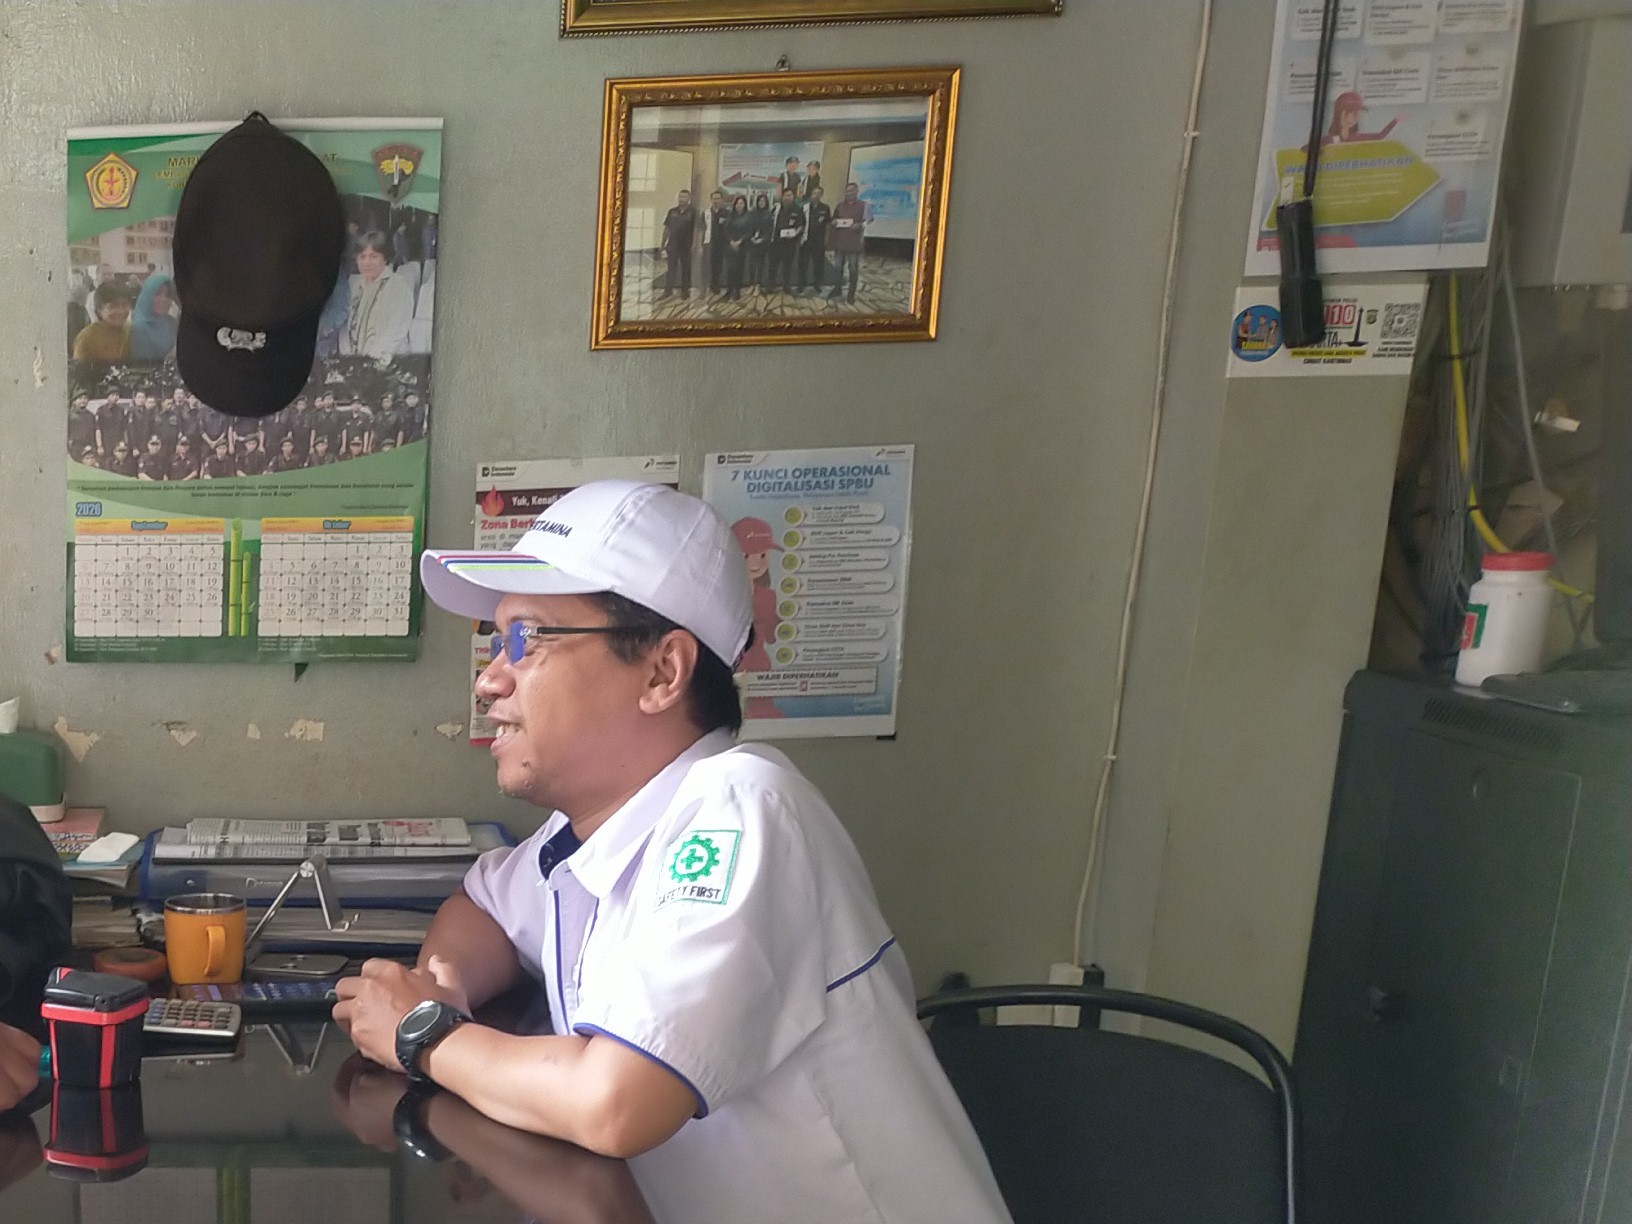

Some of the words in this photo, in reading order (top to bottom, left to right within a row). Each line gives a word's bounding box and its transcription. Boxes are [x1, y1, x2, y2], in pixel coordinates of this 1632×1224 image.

[731, 470, 741, 482] 7
[743, 467, 789, 482] KUNCI
[791, 464, 891, 480] OPERASIONAL
[746, 479, 836, 494] DIGITALISASI
[838, 477, 875, 490] SPBU
[512, 496, 530, 507] Yuk,
[480, 519, 508, 530] Zona
[125, 547, 130, 556] 1
[189, 546, 195, 555] 4
[210, 546, 216, 555] 5
[355, 545, 360, 554] 1
[104, 562, 110, 571] 7
[125, 562, 131, 571] 8
[145, 562, 152, 571] 9
[165, 562, 176, 571] 10
[186, 562, 196, 571] 11
[207, 562, 218, 570] 12
[290, 561, 296, 569] 5
[311, 561, 317, 569] 6
[333, 561, 338, 569] 7
[354, 561, 360, 569] 8
[376, 561, 382, 569] 9
[395, 560, 406, 569] 10
[101, 578, 111, 586] 14
[122, 578, 133, 586] 15
[164, 578, 175, 586] 17
[186, 577, 196, 586] 18
[207, 577, 218, 586] 19
[287, 576, 297, 585] 12
[308, 576, 318, 585] 13
[329, 576, 340, 585] 14
[351, 576, 361, 585] 15
[394, 576, 405, 584] 17
[101, 593, 111, 602] 21
[122, 593, 133, 601] 22
[164, 593, 175, 601] 24
[186, 593, 196, 601] 25
[206, 593, 218, 601] 26
[286, 592, 297, 601] 19
[307, 592, 318, 601] 20
[329, 592, 339, 600] 21
[351, 592, 361, 600] 22
[394, 591, 405, 600] 24
[101, 608, 112, 617] 28
[121, 608, 133, 617] 29
[143, 608, 154, 616] 30
[286, 607, 297, 616] 26
[307, 607, 318, 616] 27
[328, 607, 339, 616] 28
[350, 607, 361, 616] 29
[372, 607, 383, 616] 30
[394, 607, 404, 616] 31
[689, 885, 721, 899] FIRST
